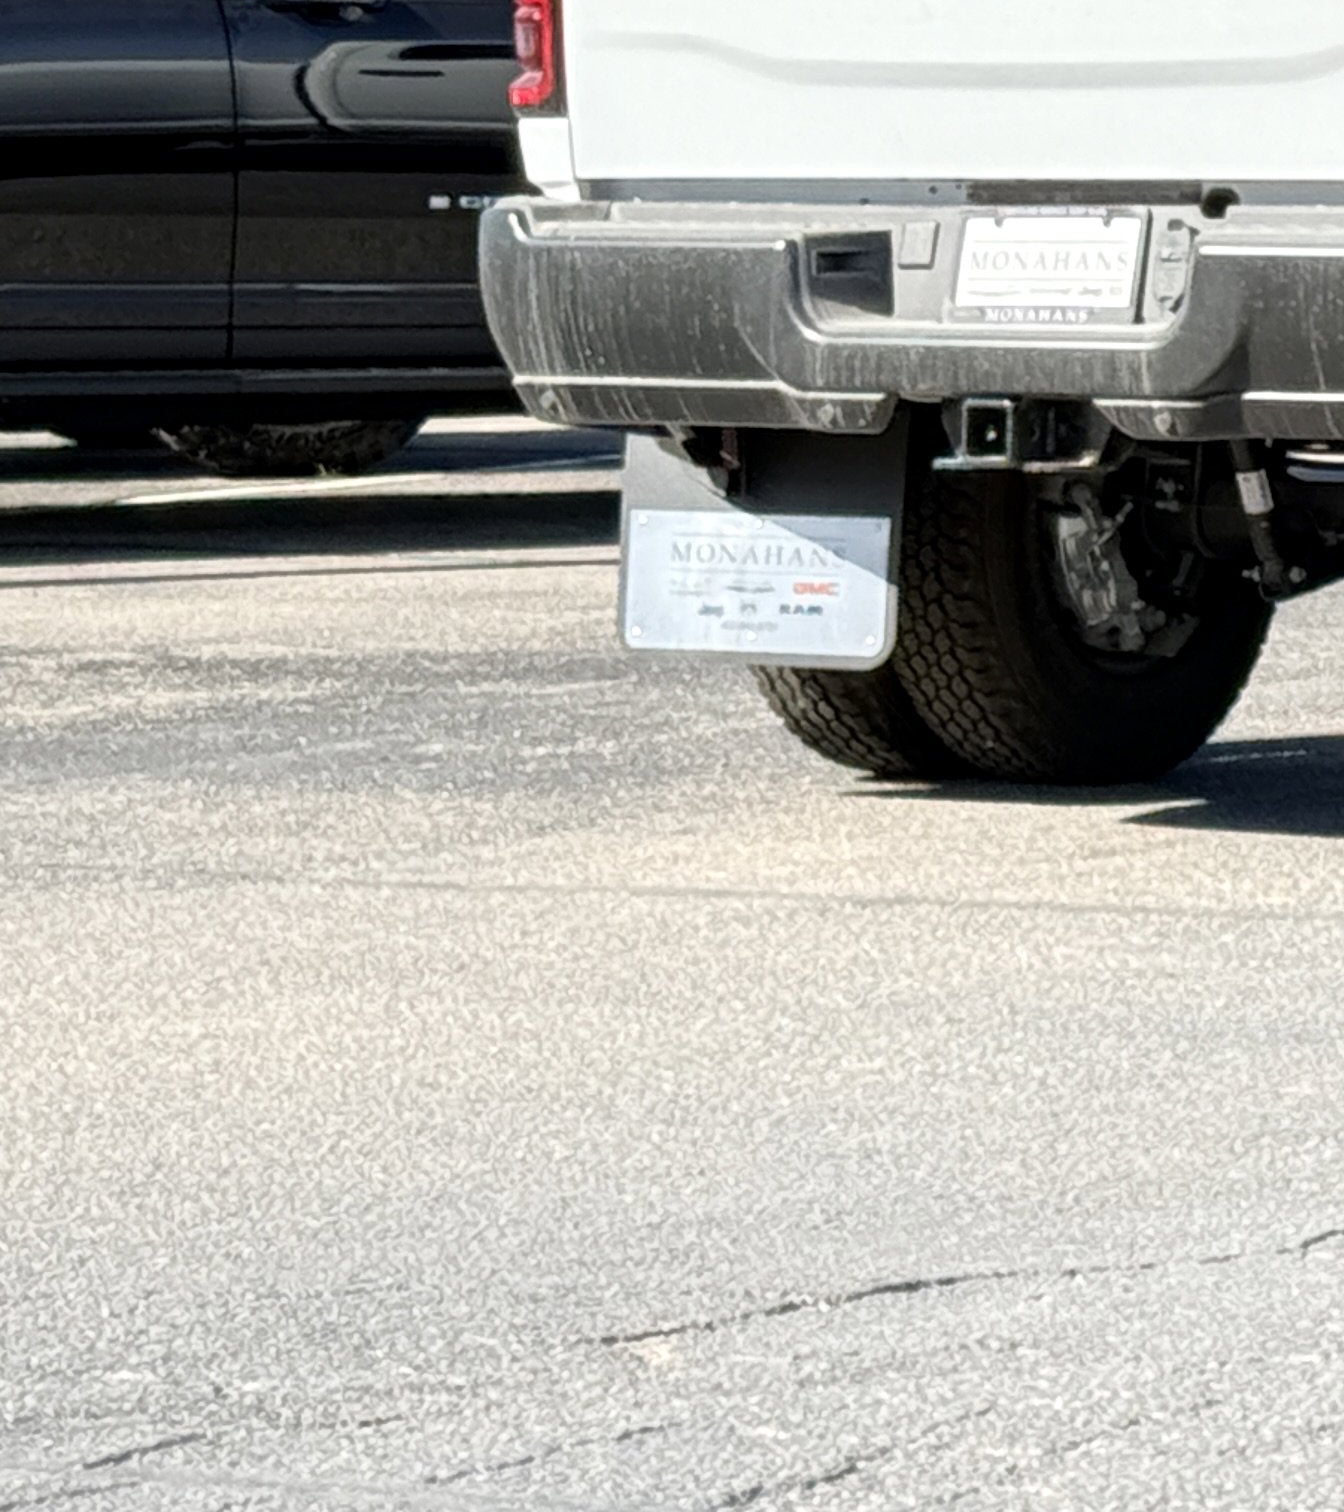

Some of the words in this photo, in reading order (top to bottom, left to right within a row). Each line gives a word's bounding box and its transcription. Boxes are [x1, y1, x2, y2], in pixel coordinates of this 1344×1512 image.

[970, 249, 1129, 272] MONAHANS
[984, 307, 1090, 324] MONAHANS
[670, 541, 847, 569] MONAHANS
[792, 581, 840, 596] GMC
